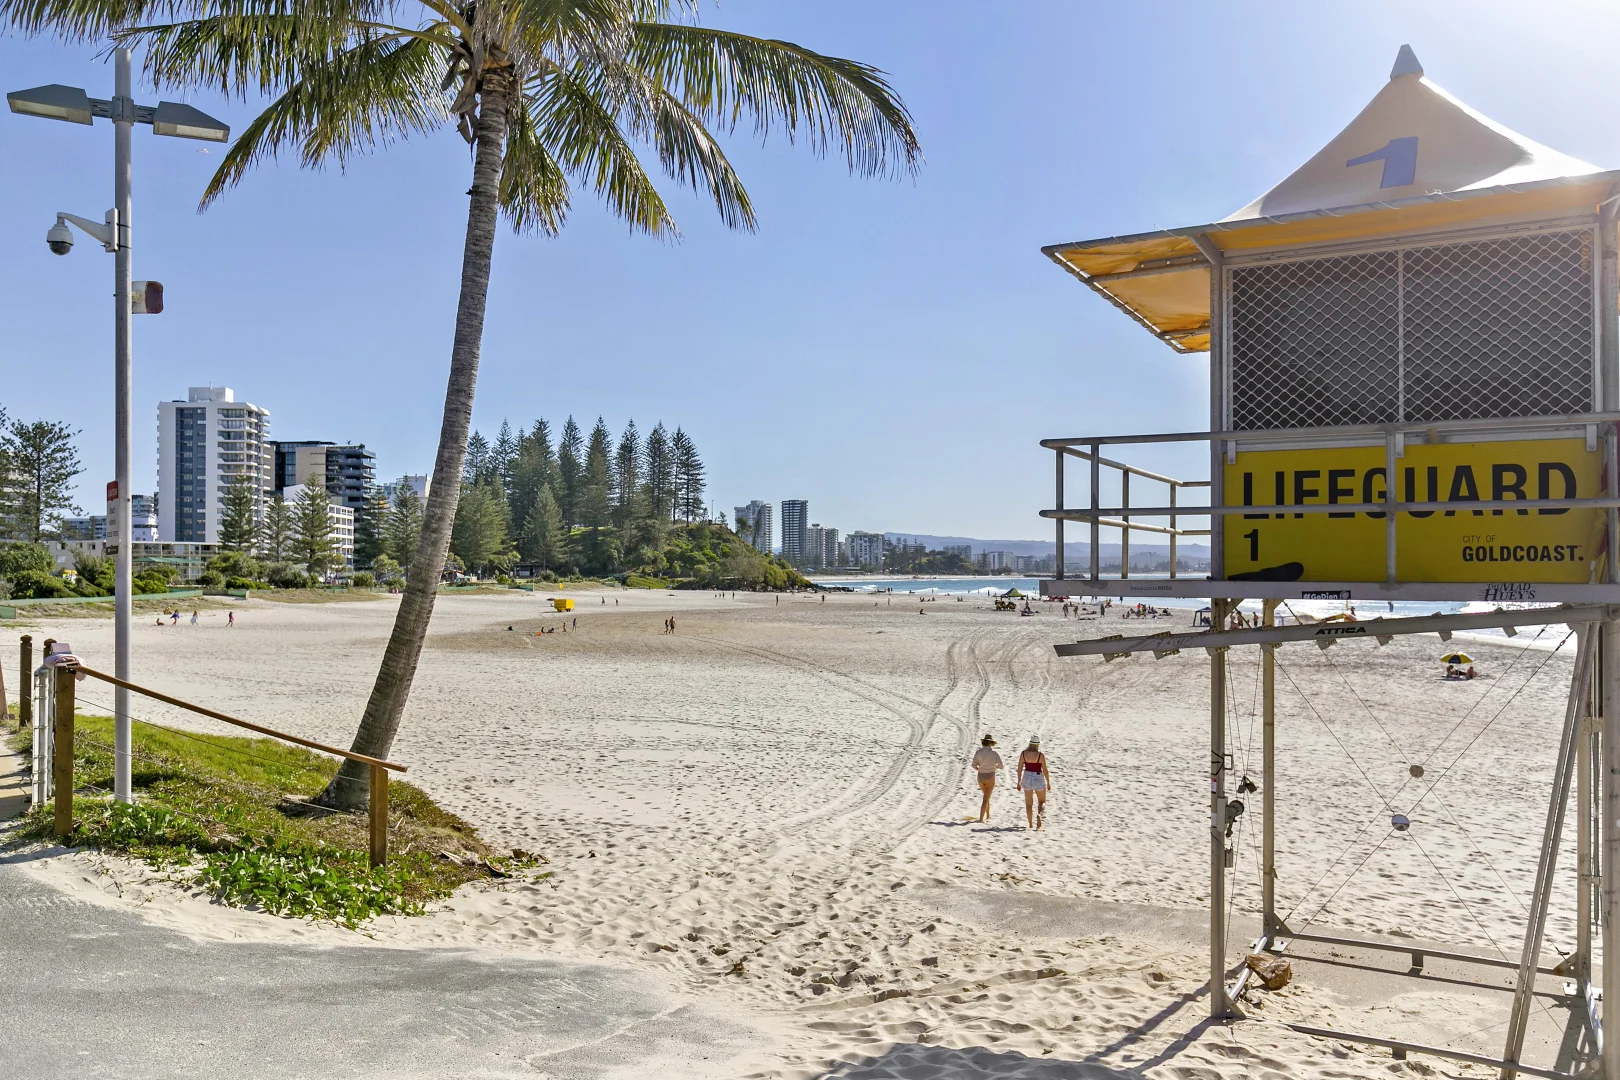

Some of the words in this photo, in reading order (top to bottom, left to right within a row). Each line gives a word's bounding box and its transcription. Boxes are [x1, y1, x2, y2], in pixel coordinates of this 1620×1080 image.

[1346, 136, 1418, 189] 1
[1244, 462, 1577, 520] LIFEGUARD
[1244, 529, 1259, 562] 1
[1462, 535, 1481, 544] CITY
[1485, 534, 1497, 543] OF
[1499, 582, 1531, 592] MAD
[1315, 627, 1366, 635] ATTICA
